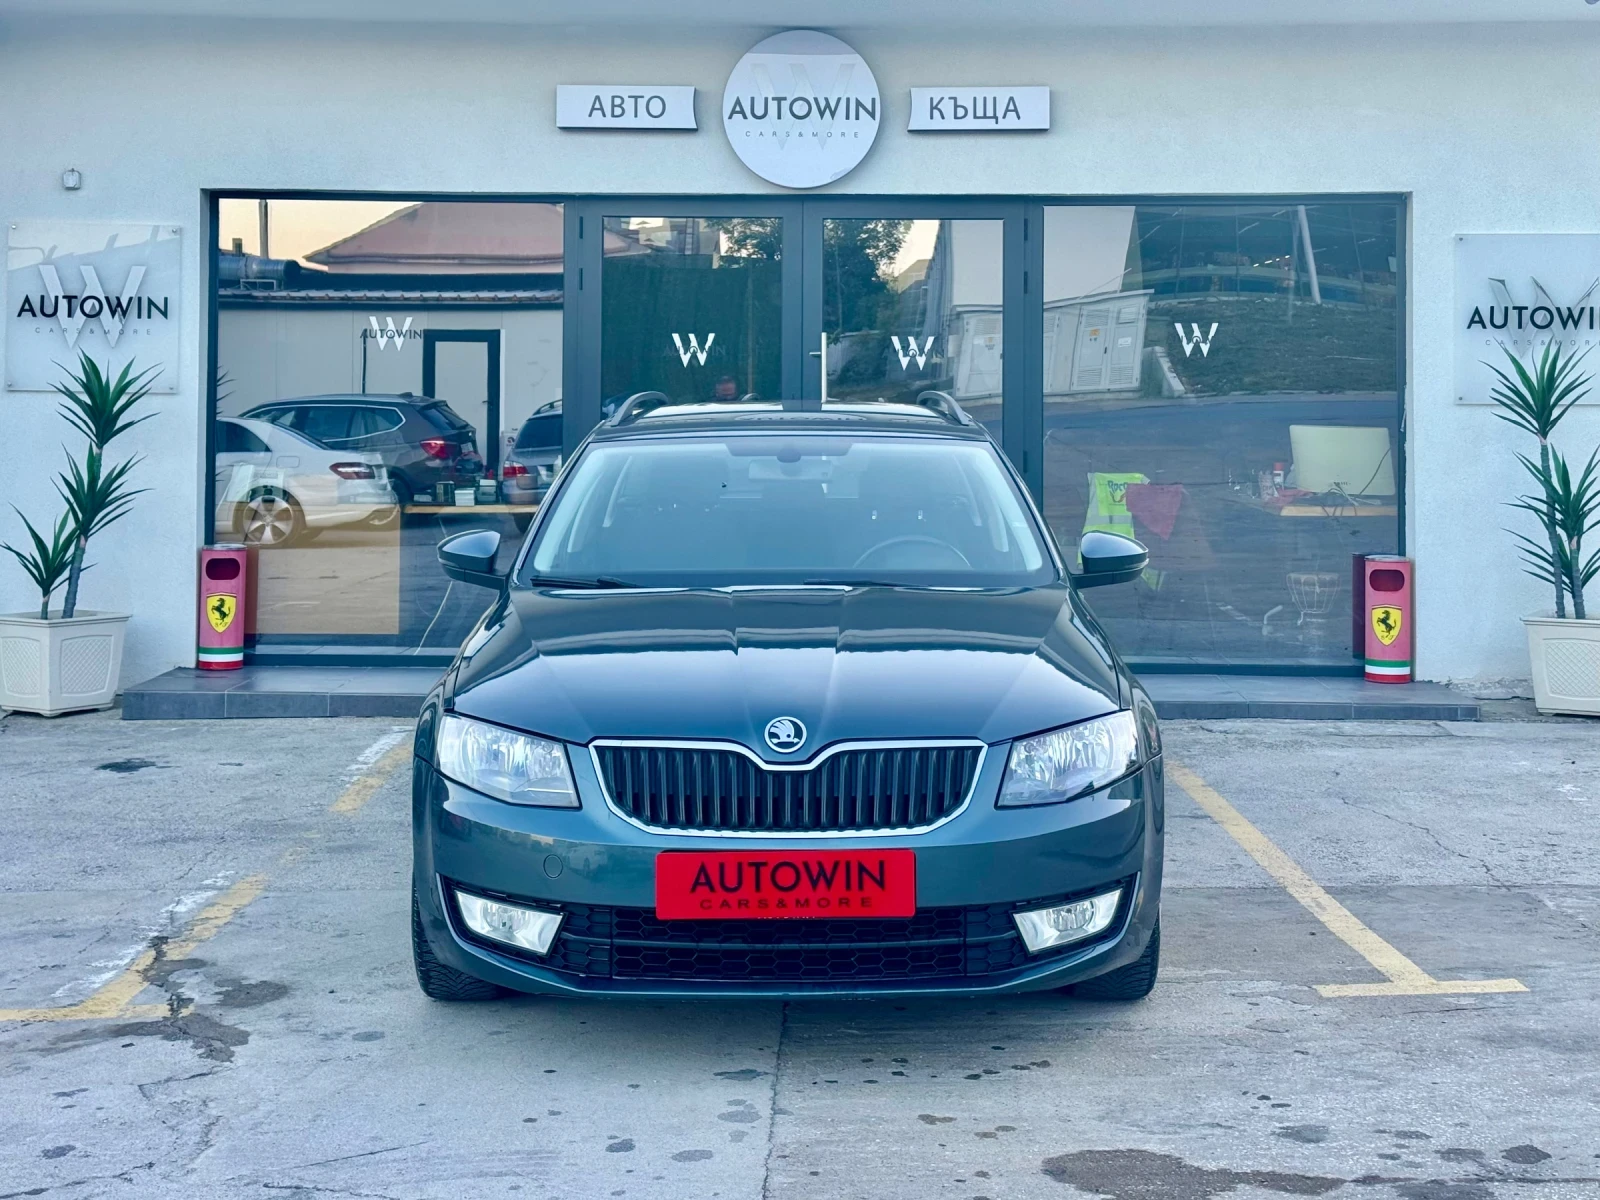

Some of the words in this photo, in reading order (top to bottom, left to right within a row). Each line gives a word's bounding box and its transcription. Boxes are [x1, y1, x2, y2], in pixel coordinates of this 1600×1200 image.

[588, 94, 667, 119] АВТО
[727, 96, 876, 121] AUTOWIN
[929, 96, 1021, 125] КЪЩА
[745, 130, 859, 139] CARS&MORE
[16, 294, 169, 320] AUTOWIN
[1466, 305, 1600, 331] AUTOWI
[34, 327, 151, 336] CARS&MORE
[359, 328, 422, 340] AUTOWIN
[1485, 338, 1600, 347] CARS&MOR
[690, 860, 885, 893] AUTOWIN
[699, 896, 873, 911] CARS&MORE
